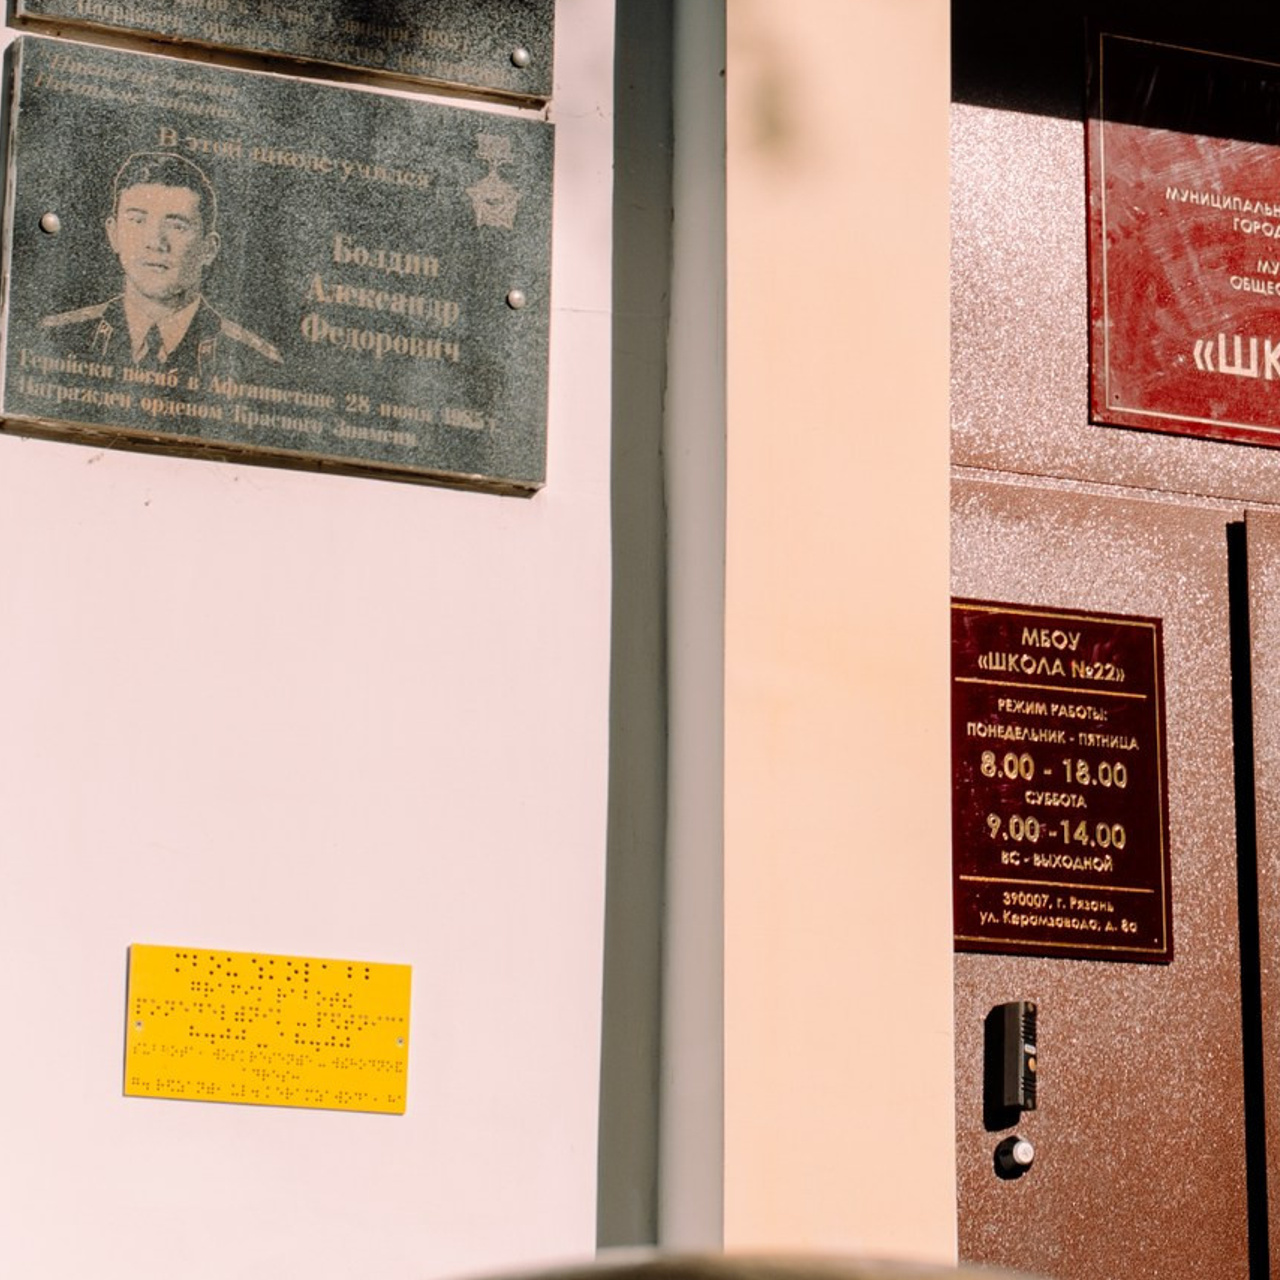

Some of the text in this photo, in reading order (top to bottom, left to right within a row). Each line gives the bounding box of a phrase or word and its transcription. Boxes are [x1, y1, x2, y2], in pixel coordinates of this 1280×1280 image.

[157, 126, 178, 146] В
[185, 135, 242, 158] этой
[252, 146, 332, 172] школе
[332, 231, 439, 277] Болдин
[304, 272, 460, 327] Александр
[300, 312, 460, 363] Федорович
[18, 348, 114, 379] Геройски
[123, 367, 179, 388] погиб
[186, 376, 200, 391] в
[209, 374, 335, 409] Афганистане
[345, 393, 371, 414] 28
[17, 376, 131, 410] Награжден
[141, 396, 223, 421] орденом
[233, 403, 324, 434] Красного
[1021, 627, 1081, 651] МБОУ
[977, 651, 1126, 683] «ШКОЛА №22»
[998, 698, 1109, 721] РЕЖИМ РАБОТЫ:
[967, 721, 1067, 744] ПОНЕДЕЛЬНИК
[1079, 732, 1140, 751] ПЯТНИЦА
[980, 750, 1035, 781] 8.00
[1062, 758, 1128, 789] 18.00
[1025, 790, 1088, 808] СУББОТА
[986, 813, 1041, 843] 9.00
[1001, 850, 1021, 866] ВС
[1033, 853, 1113, 872] ВЫХОДНОЙ
[1003, 891, 1115, 913] 390007, г. Рязань
[979, 910, 1138, 933] ул. Керамзавода, д. 8а
